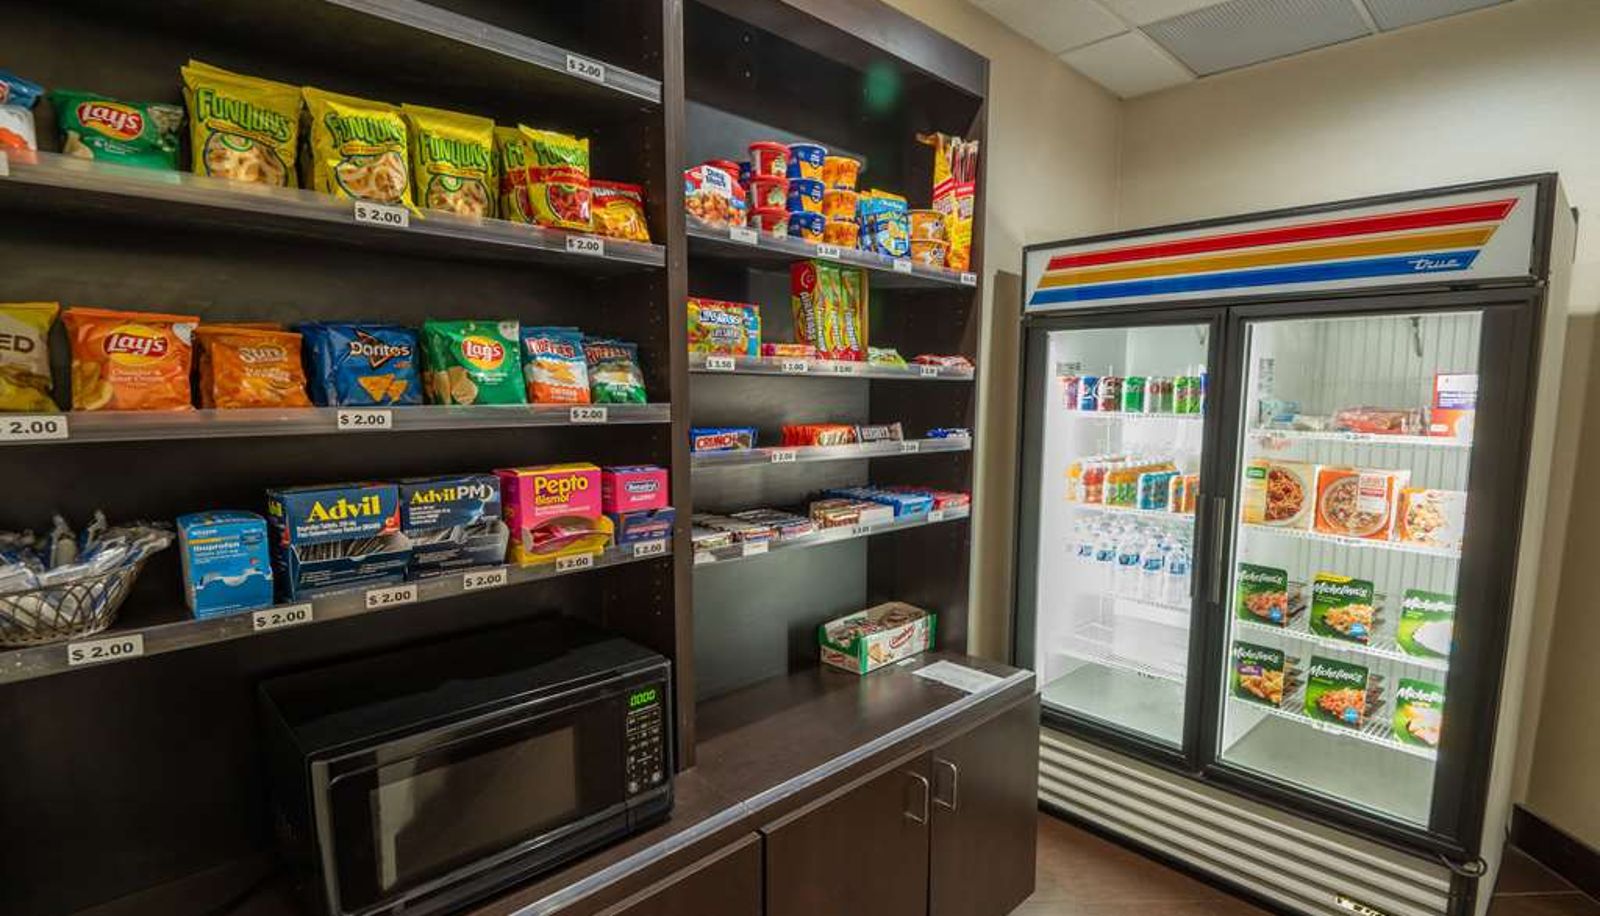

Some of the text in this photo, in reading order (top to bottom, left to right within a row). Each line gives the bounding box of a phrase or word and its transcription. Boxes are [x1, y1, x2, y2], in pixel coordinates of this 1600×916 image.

[569, 60, 601, 77] $ 2.00
[357, 207, 402, 225] $ 2.00
[567, 239, 600, 251] $ 2.00
[1407, 258, 1461, 271] True
[107, 334, 165, 356] Lay's
[349, 341, 411, 357] Doritos
[466, 341, 501, 362] Lay's
[340, 414, 386, 426] $ 2.00
[572, 410, 603, 418] $ 2.00
[9, 421, 58, 434] 2.00
[534, 475, 589, 496] Pepto
[411, 484, 486, 505] Advil PM
[309, 495, 381, 523] Advil
[642, 543, 662, 553] 2.00
[566, 557, 589, 568] 2.00
[465, 574, 501, 587] $ 2.00
[368, 590, 411, 606] $ 2.00
[1312, 582, 1369, 598] Michelina's
[257, 610, 306, 628] $ 2.00
[72, 642, 134, 662] $ 2.00
[1310, 664, 1363, 683] Michelina's
